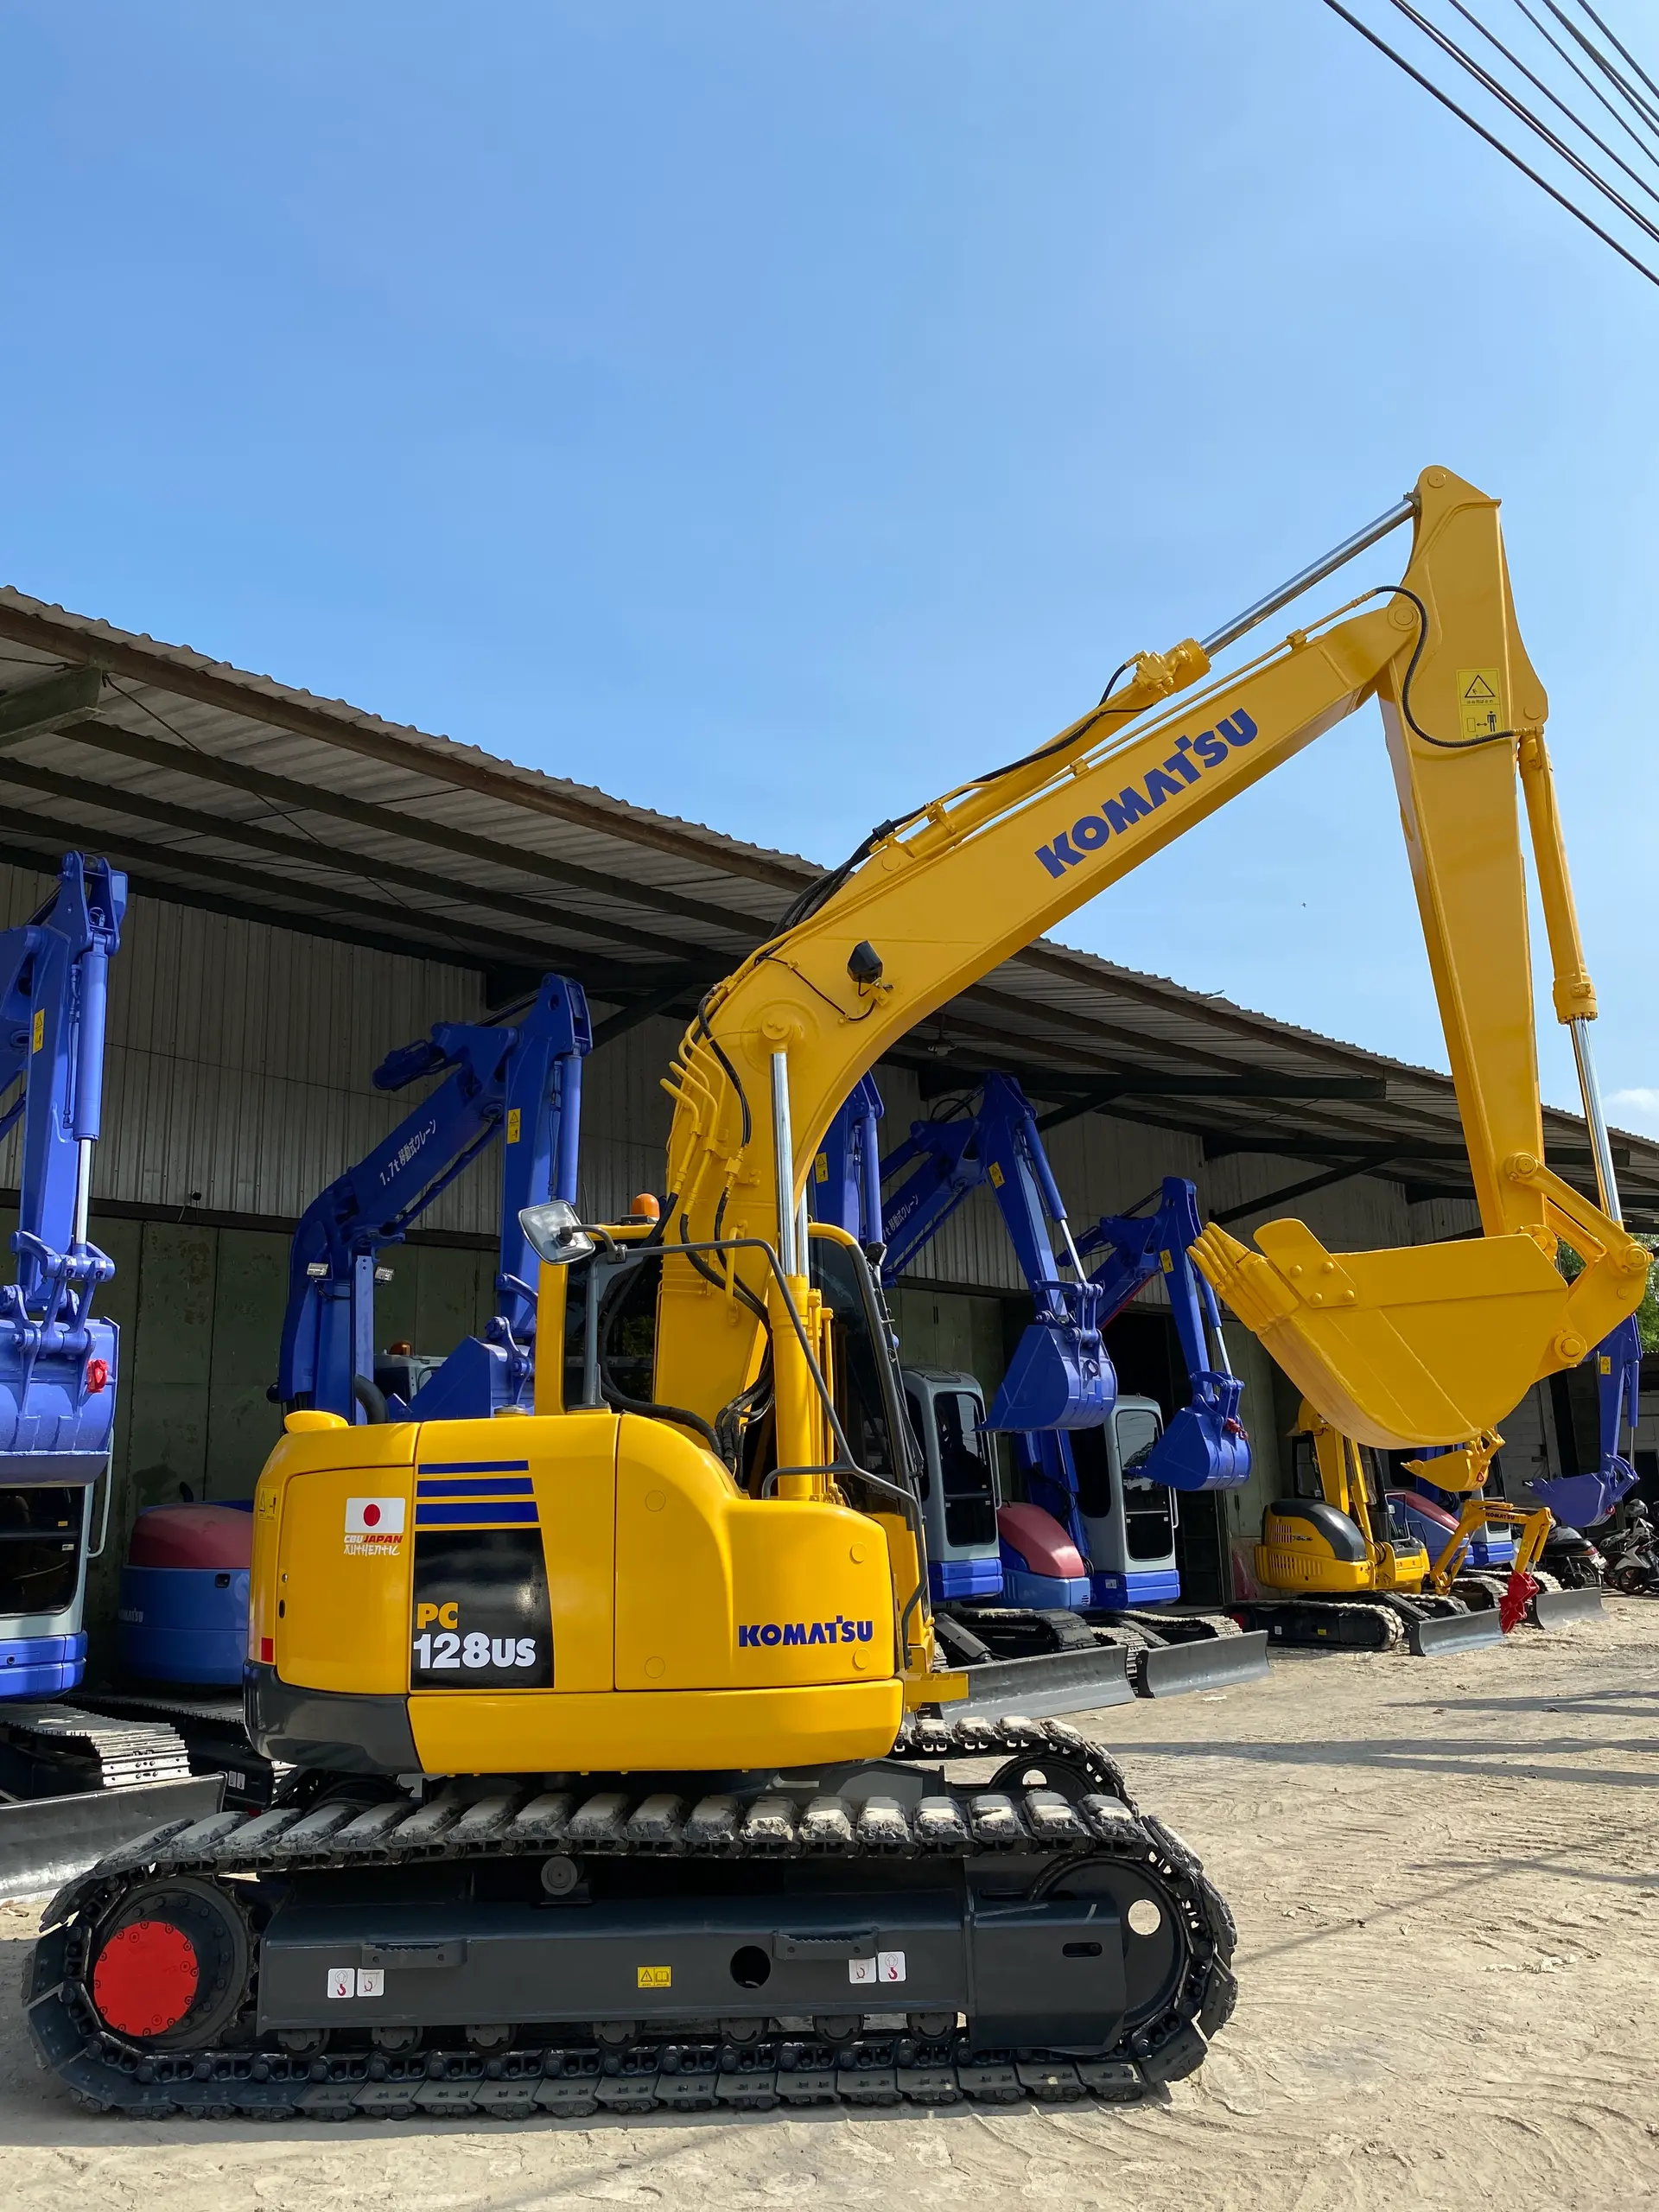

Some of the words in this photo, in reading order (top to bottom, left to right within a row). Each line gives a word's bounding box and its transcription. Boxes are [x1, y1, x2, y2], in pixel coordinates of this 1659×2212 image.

[1034, 708, 1258, 879] KOMATSU
[363, 1535, 403, 1543] JAPAN
[416, 1602, 459, 1630] PC
[739, 1615, 874, 1648] KOMATSU
[413, 1631, 537, 1669] 128US
